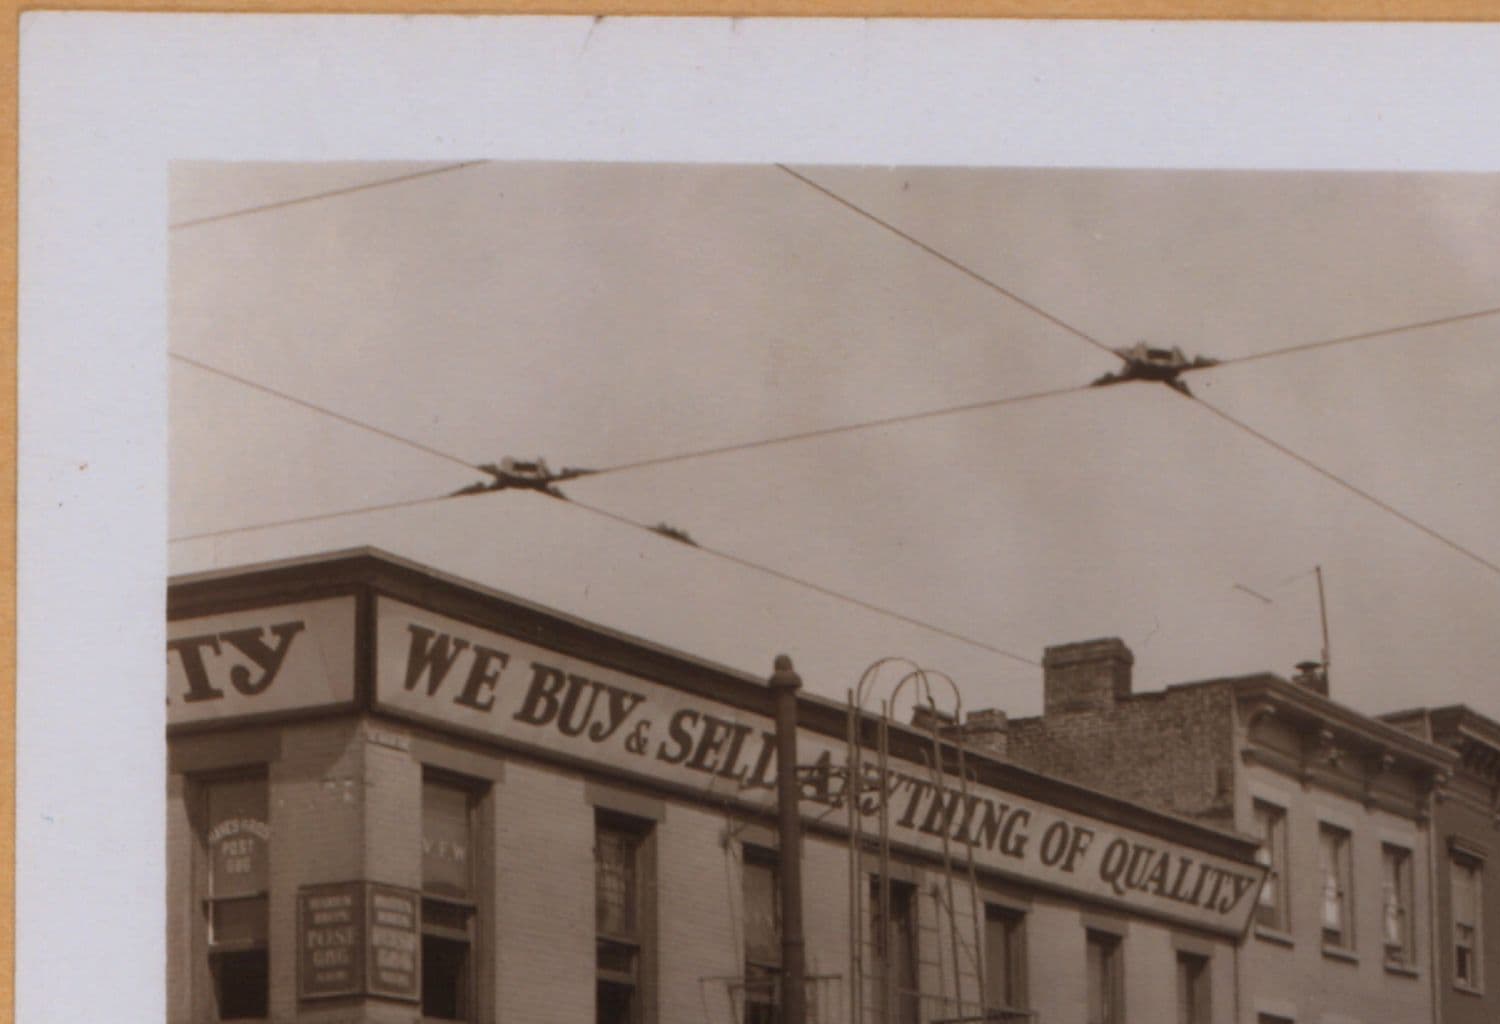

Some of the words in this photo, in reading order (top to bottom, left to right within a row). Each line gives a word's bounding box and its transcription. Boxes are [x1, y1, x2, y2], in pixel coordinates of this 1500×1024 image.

[167, 620, 305, 703] TY
[403, 623, 510, 713] WE
[513, 660, 648, 743] BUY
[624, 718, 652, 757] &
[656, 706, 779, 790] SELL
[1039, 820, 1095, 873] OF
[1100, 837, 1257, 915] QUALITY
